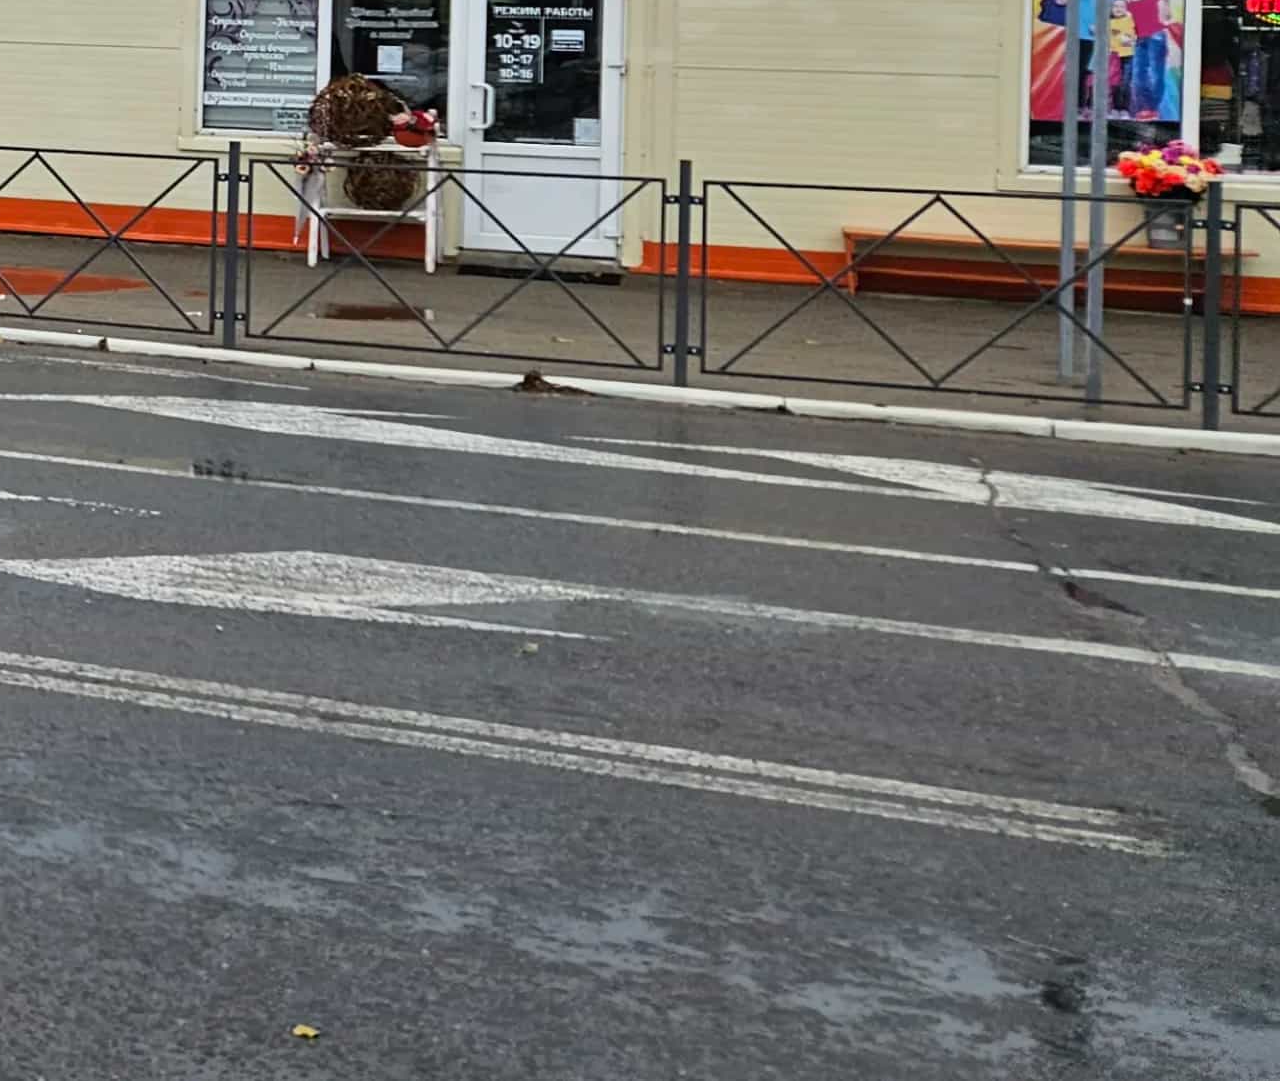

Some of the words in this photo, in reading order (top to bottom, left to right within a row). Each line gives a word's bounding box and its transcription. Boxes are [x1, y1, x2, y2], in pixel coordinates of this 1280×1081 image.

[493, 5, 541, 16] РЕЖИМ
[544, 6, 593, 17] РАБОТЫ
[494, 33, 541, 49] 10-19
